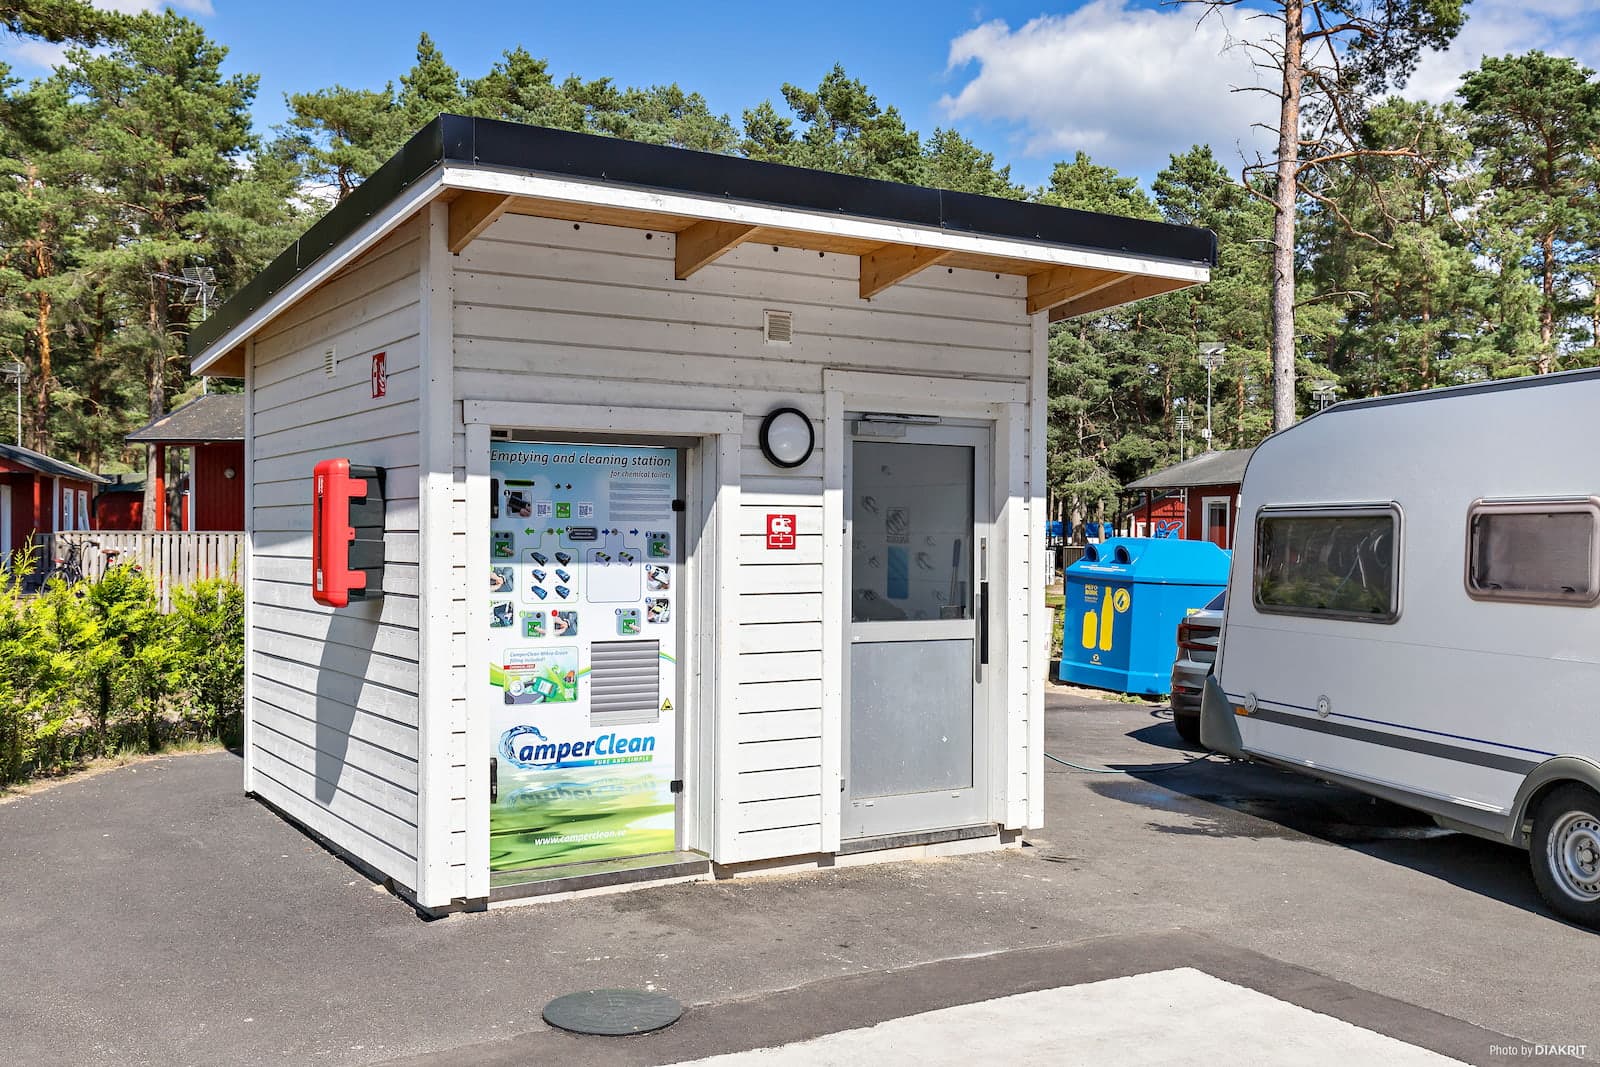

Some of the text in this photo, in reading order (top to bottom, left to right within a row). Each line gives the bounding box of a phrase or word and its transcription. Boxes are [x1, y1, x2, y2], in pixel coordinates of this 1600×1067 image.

[490, 449, 672, 467] Emptying and cleaning station
[610, 470, 671, 479] for chemical toilets
